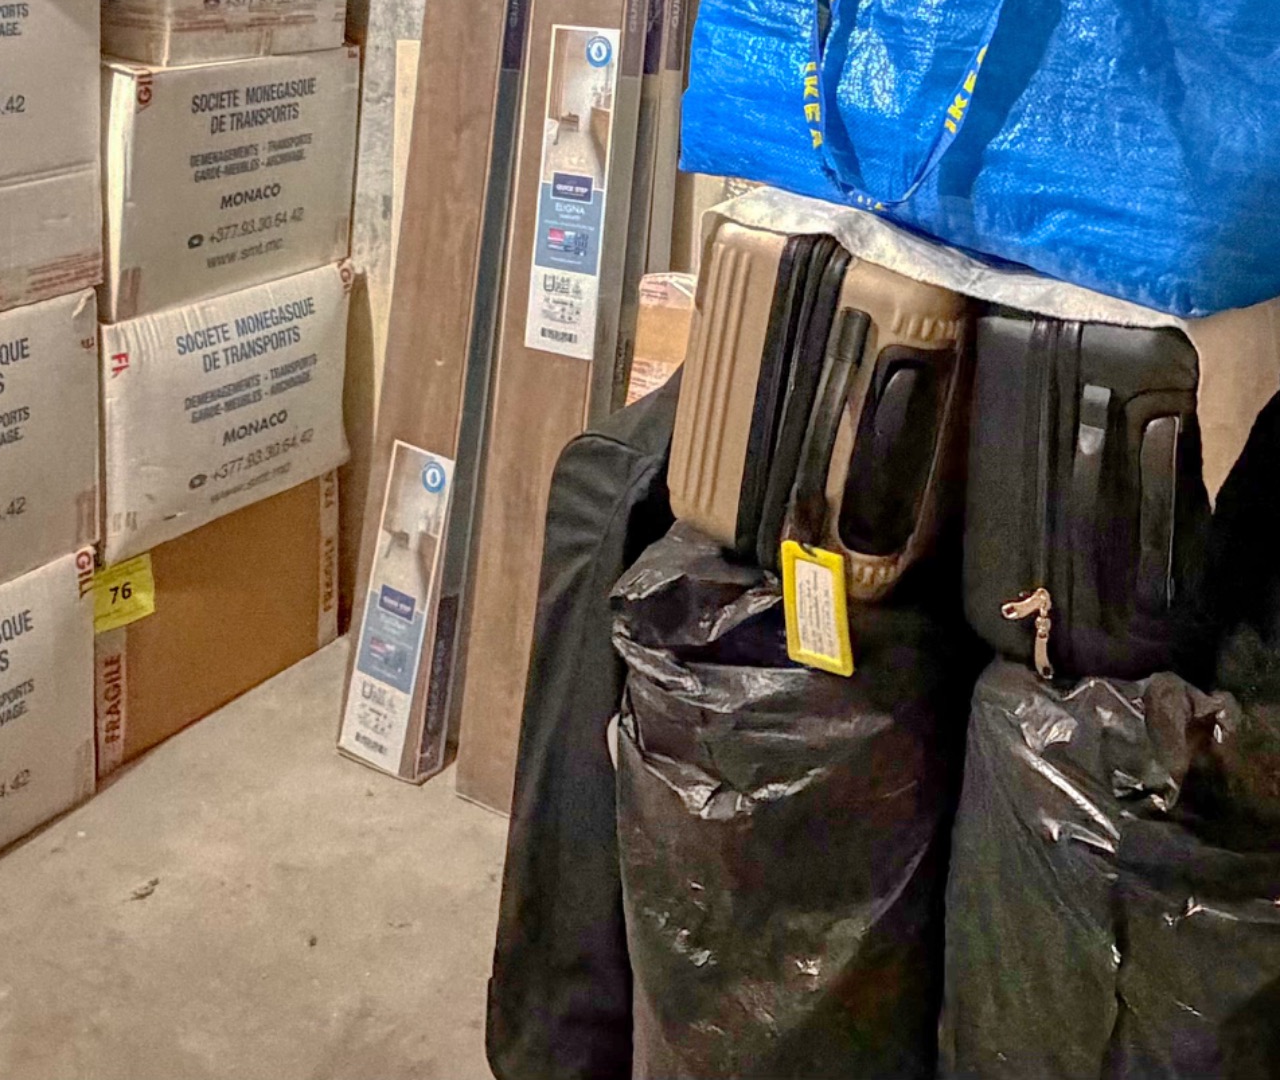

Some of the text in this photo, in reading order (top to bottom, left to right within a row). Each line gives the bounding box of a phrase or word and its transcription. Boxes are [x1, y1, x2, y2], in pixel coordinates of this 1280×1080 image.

[191, 77, 317, 114] SOCIETE MONEGASQUE
[210, 103, 300, 135] DE TRANSPORTS
[220, 183, 282, 209] MONACO
[176, 297, 316, 356] SOCIETE MONEGASQUE
[202, 326, 301, 373] DE TRANSPORTS
[222, 409, 288, 447] MONACO
[109, 581, 132, 605] 76
[103, 652, 122, 746] FRAGILE
